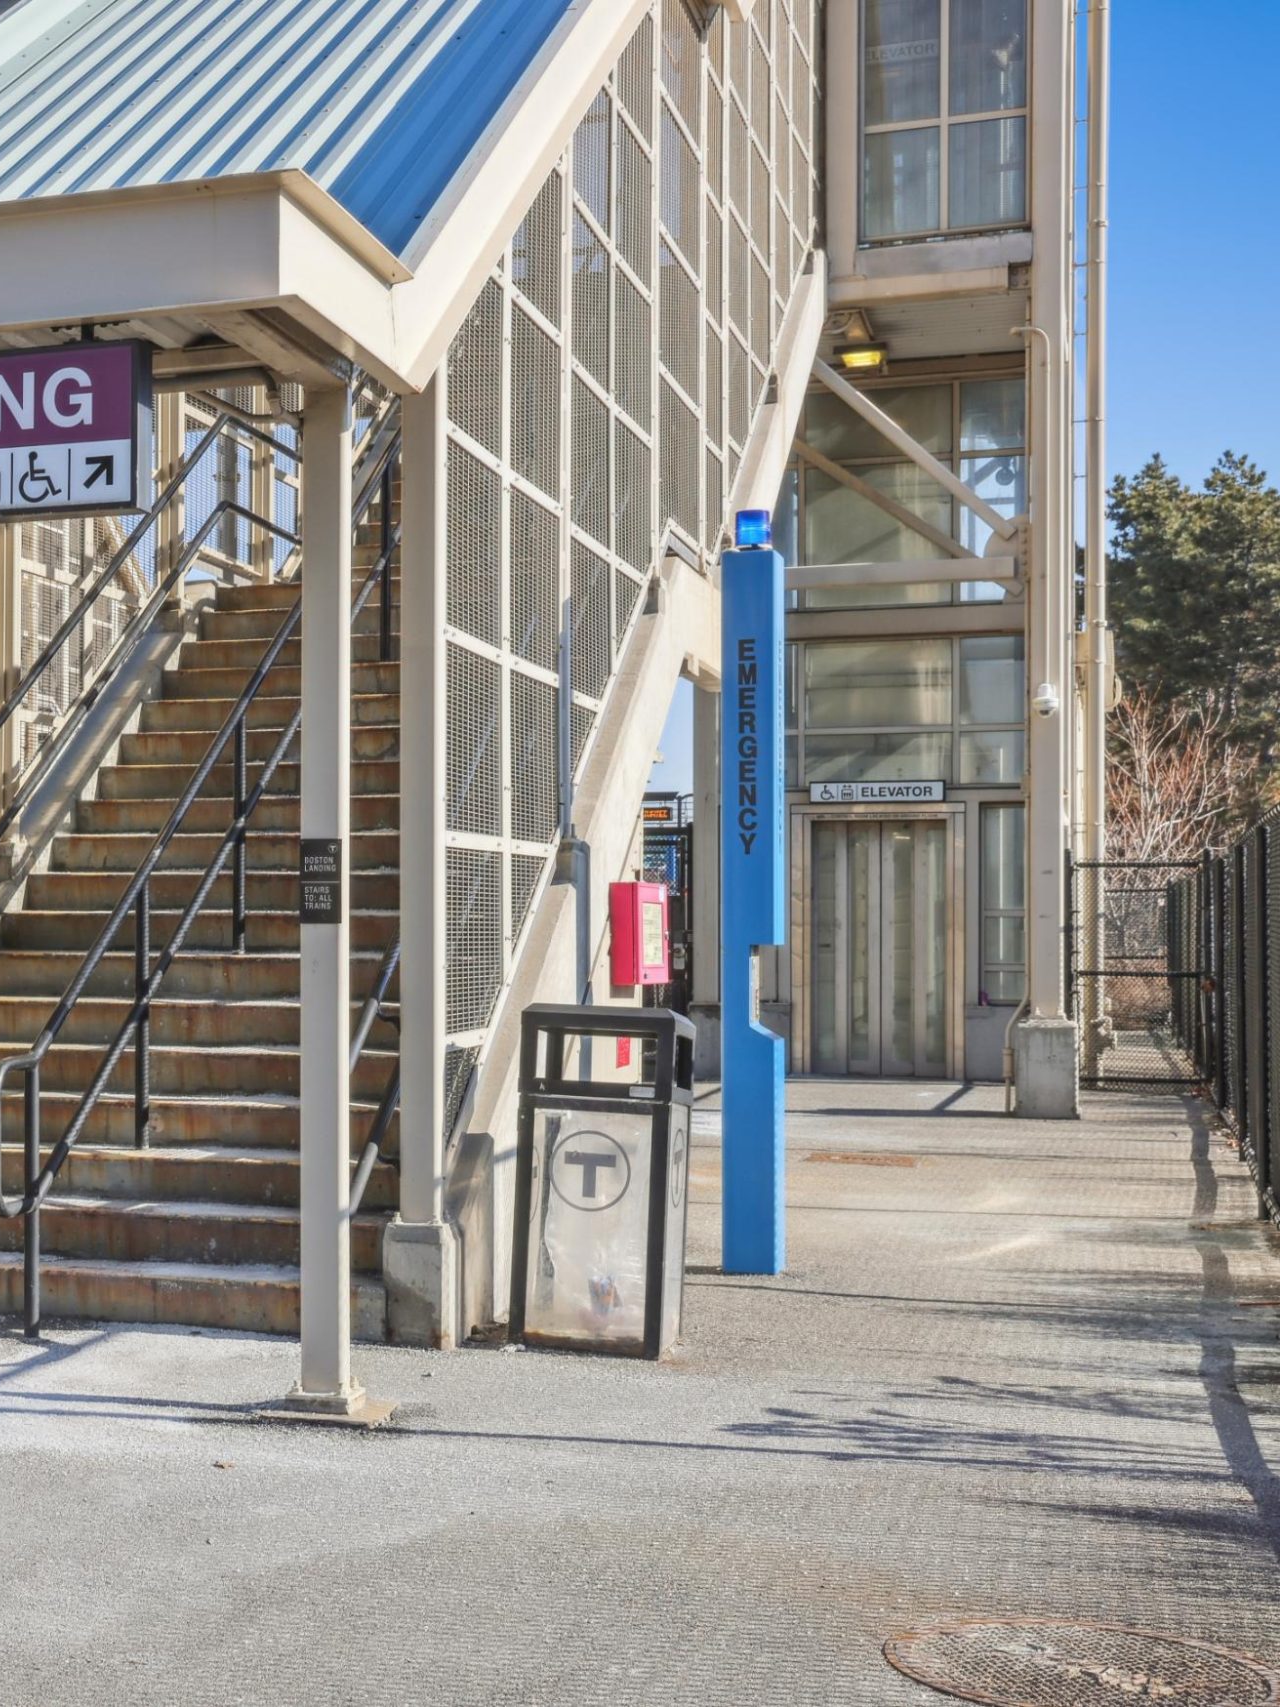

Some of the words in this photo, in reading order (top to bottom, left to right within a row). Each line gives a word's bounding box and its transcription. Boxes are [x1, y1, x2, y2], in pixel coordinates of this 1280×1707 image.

[736, 638, 758, 856] EMERGENCY
[860, 785, 933, 798] ELEVATOR
[304, 856, 335, 864] BOSTON
[304, 864, 337, 872] LANDING
[304, 886, 330, 894] STAIRS
[304, 894, 318, 902] TO:
[319, 894, 333, 902] ALL
[304, 902, 332, 910] TRAINS
[564, 1150, 617, 1198] T
